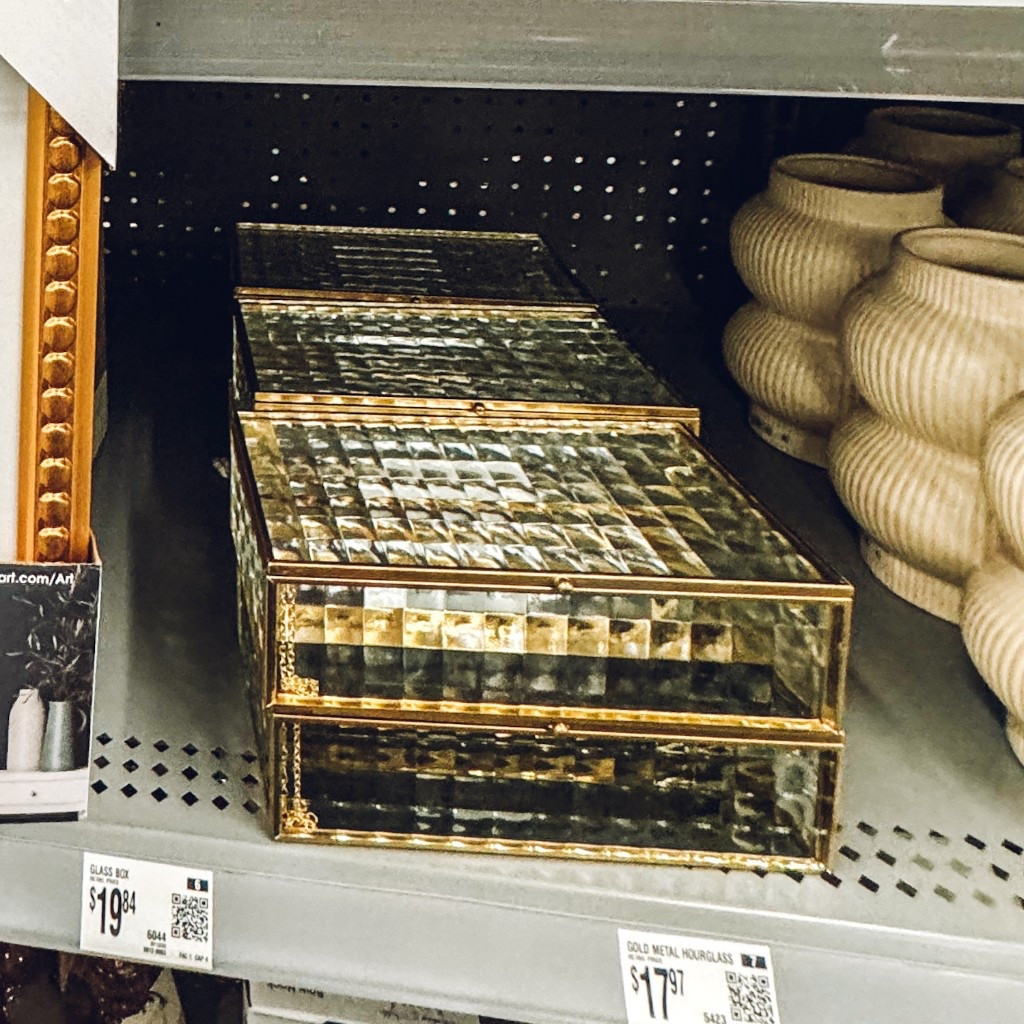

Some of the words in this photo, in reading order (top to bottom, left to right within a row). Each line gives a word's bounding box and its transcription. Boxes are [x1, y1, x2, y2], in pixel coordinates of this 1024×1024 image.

[90, 864, 113, 877] GLASS
[115, 868, 130, 879] BOX
[147, 929, 166, 942] 6044
[627, 941, 649, 954] GOLD
[652, 944, 680, 959] METAL
[682, 947, 734, 966] HOURGLASS
